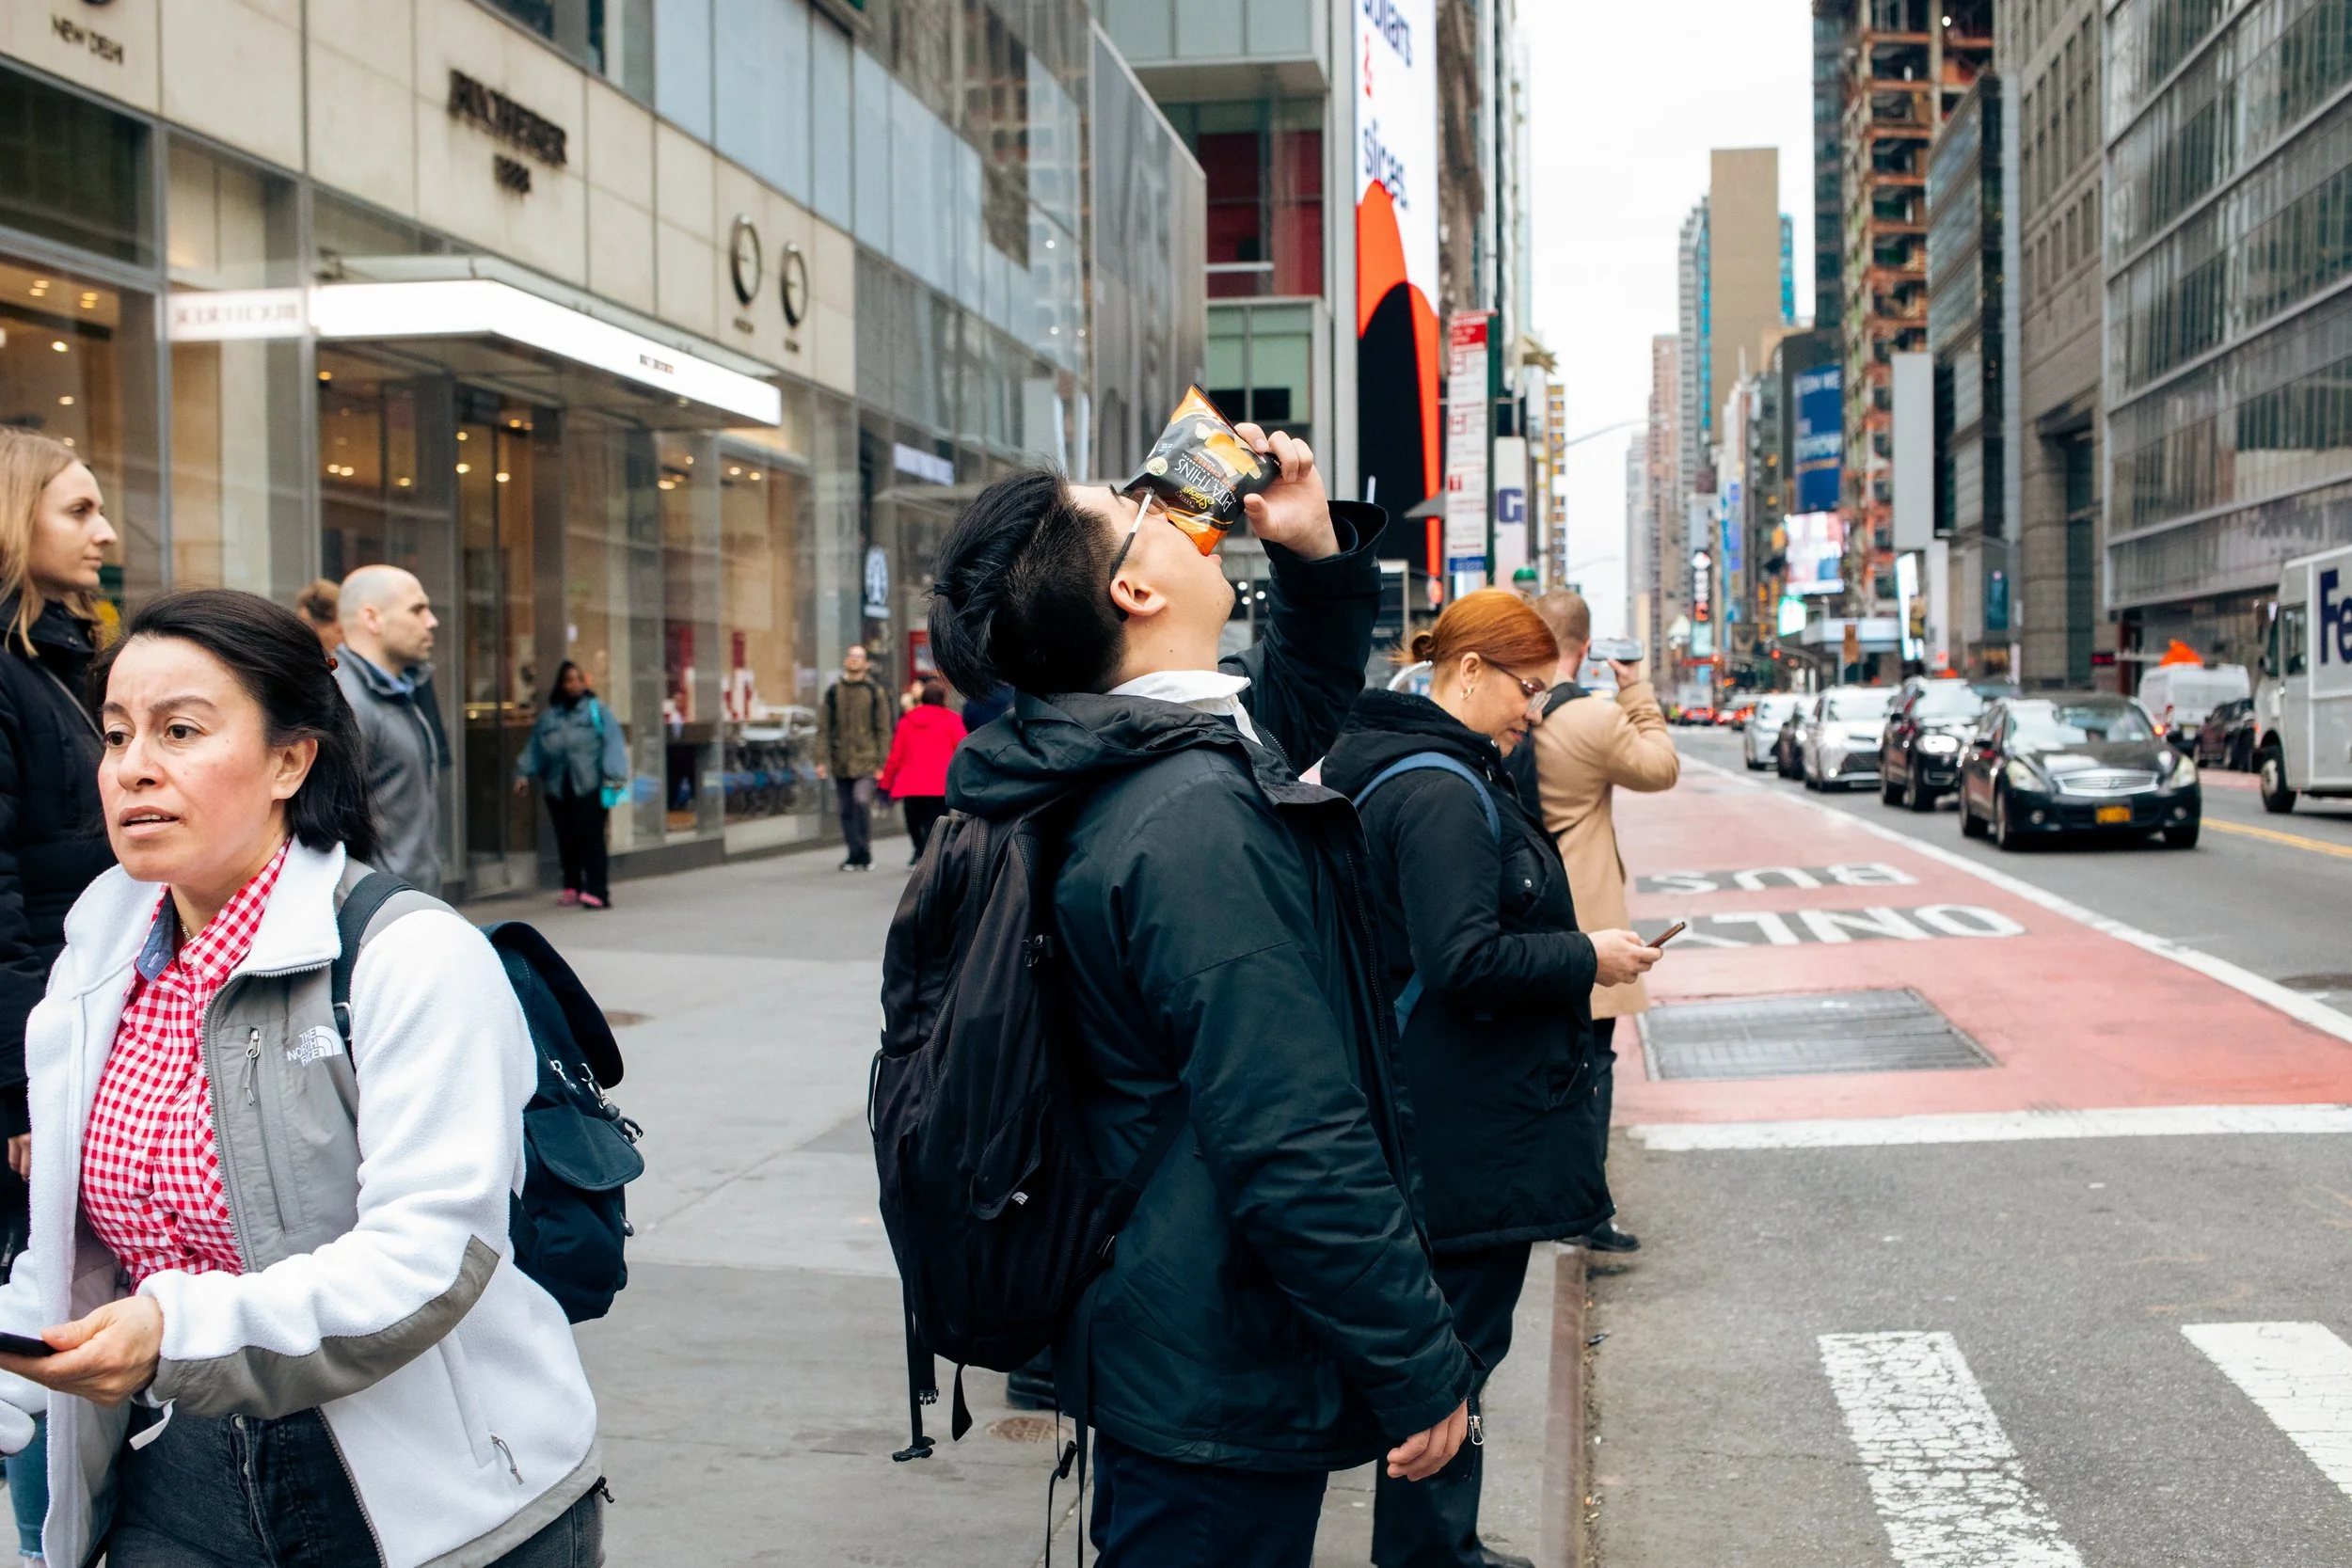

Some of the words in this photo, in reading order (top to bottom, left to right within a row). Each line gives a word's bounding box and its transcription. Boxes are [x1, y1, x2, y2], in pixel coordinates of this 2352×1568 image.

[1173, 457, 1208, 493] THINS
[1192, 453, 1221, 478] CHEESE
[1180, 485, 1216, 510] Stacy's
[1212, 483, 1233, 513] PITA
[1650, 863, 1918, 895] BUS
[1663, 903, 2027, 949] ONLY
[298, 1028, 317, 1044] THE
[286, 1037, 319, 1062] NORTH
[300, 1048, 321, 1068] FACE
